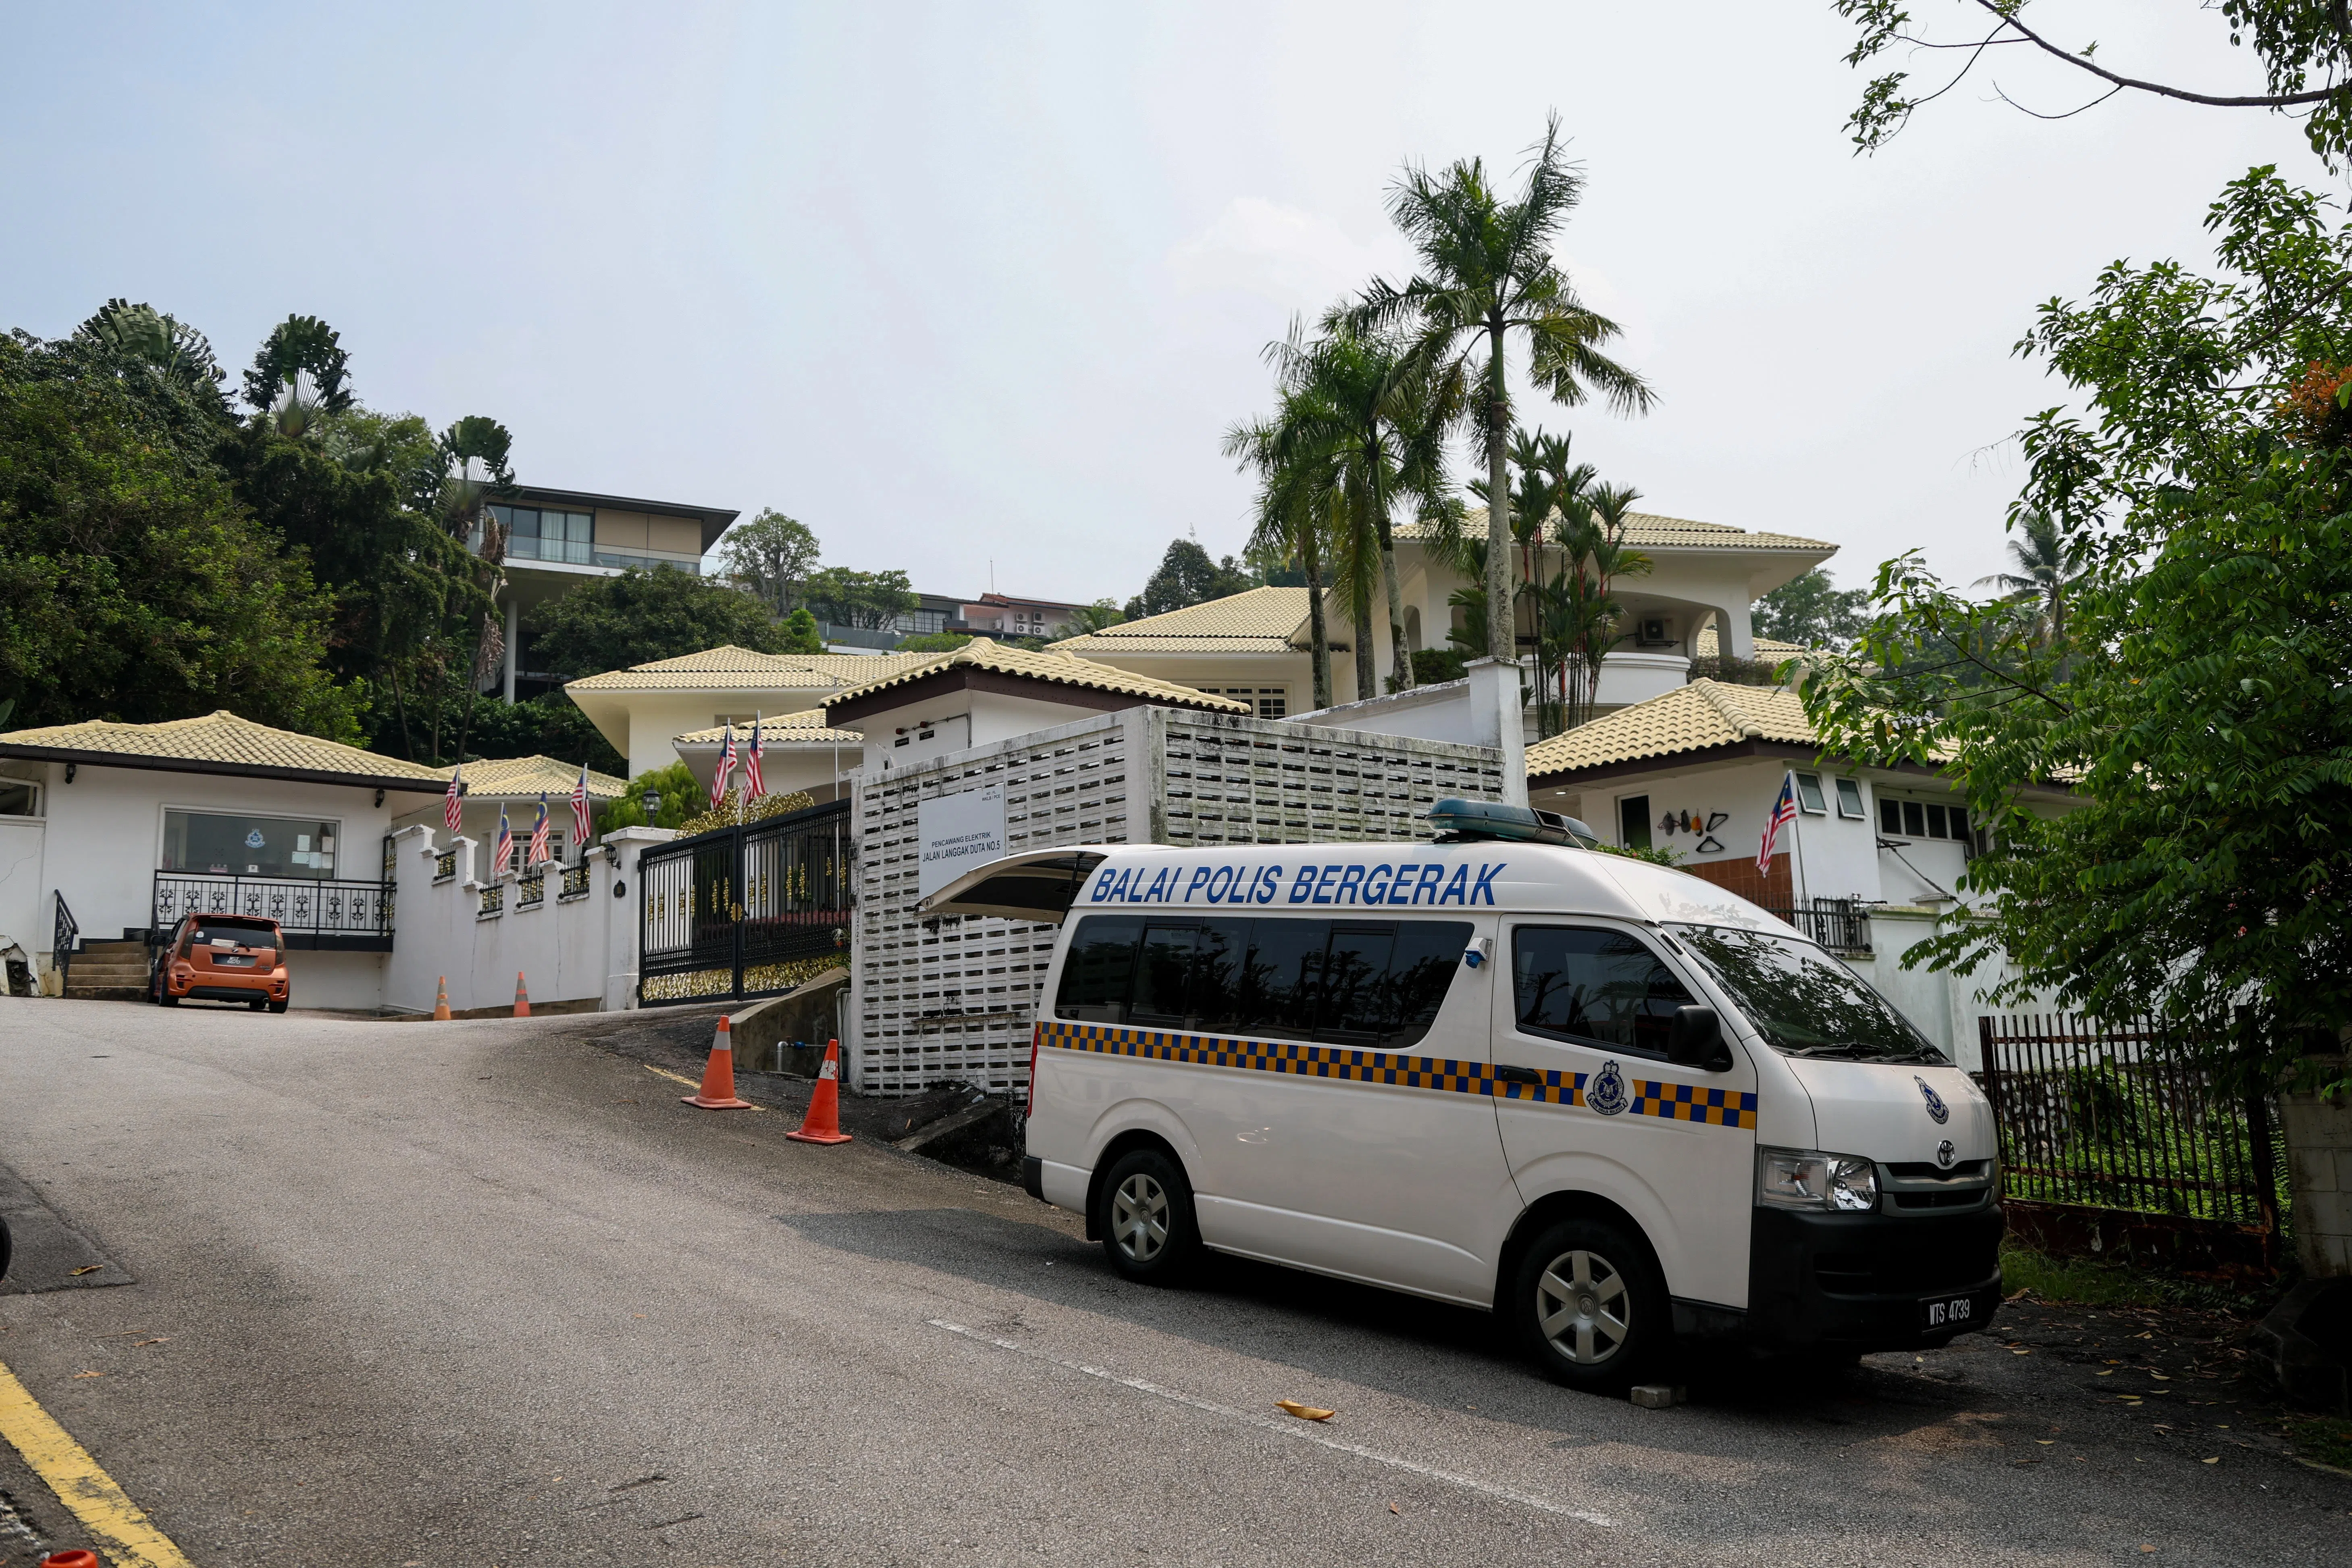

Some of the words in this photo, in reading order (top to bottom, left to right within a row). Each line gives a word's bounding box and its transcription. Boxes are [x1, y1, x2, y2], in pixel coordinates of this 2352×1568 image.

[932, 836, 964, 848] PENCAWANG
[965, 831, 991, 842] ELEKTRIK
[922, 850, 940, 862] JALAN
[942, 845, 969, 859] LANGGAK
[970, 841, 985, 854] DUTA
[986, 840, 1000, 852] NO.5
[1091, 867, 1182, 903] BALAI
[1184, 865, 1283, 904] POLIS
[1288, 863, 1507, 905] BERGERAK
[1610, 1105, 1623, 1113] MALAYSIA
[1930, 1303, 1945, 1325] WTS
[1949, 1299, 1970, 1321] 4739
